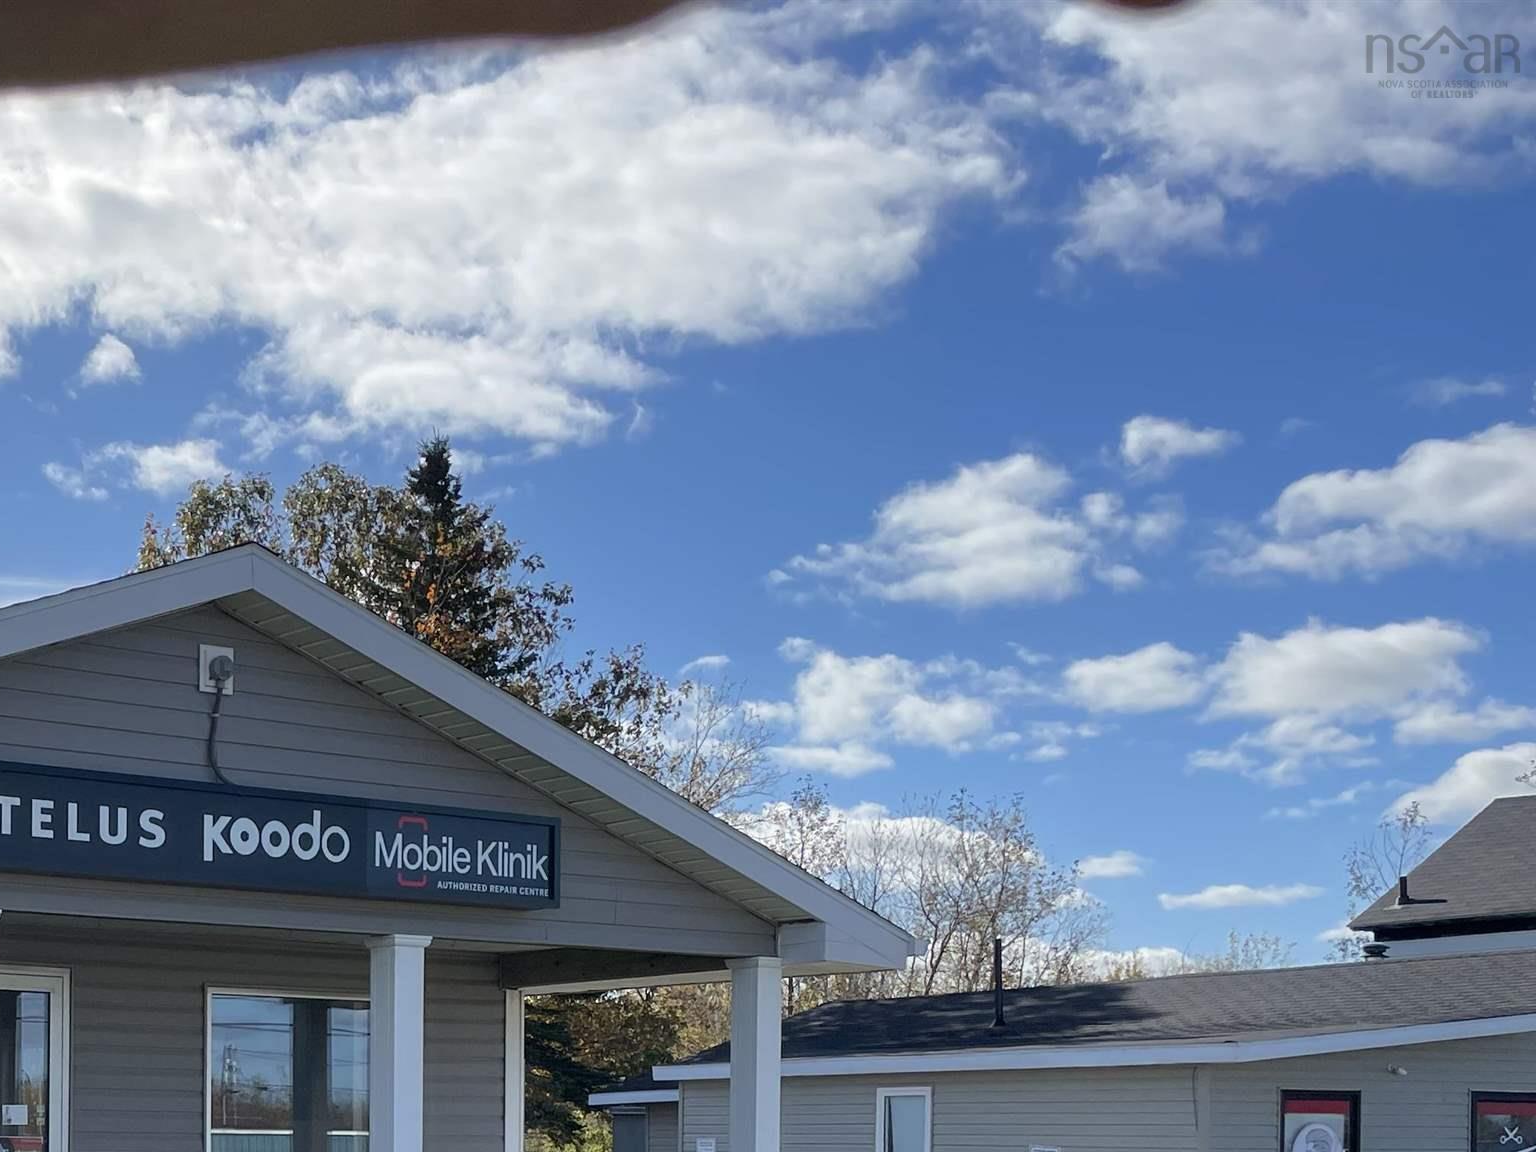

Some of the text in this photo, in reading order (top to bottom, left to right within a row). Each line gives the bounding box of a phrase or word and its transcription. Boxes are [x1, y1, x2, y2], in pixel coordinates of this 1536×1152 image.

[374, 830, 549, 882] Mobile Klinik
[437, 880, 549, 897] AUTHORIZED REPAIR CENTRE
